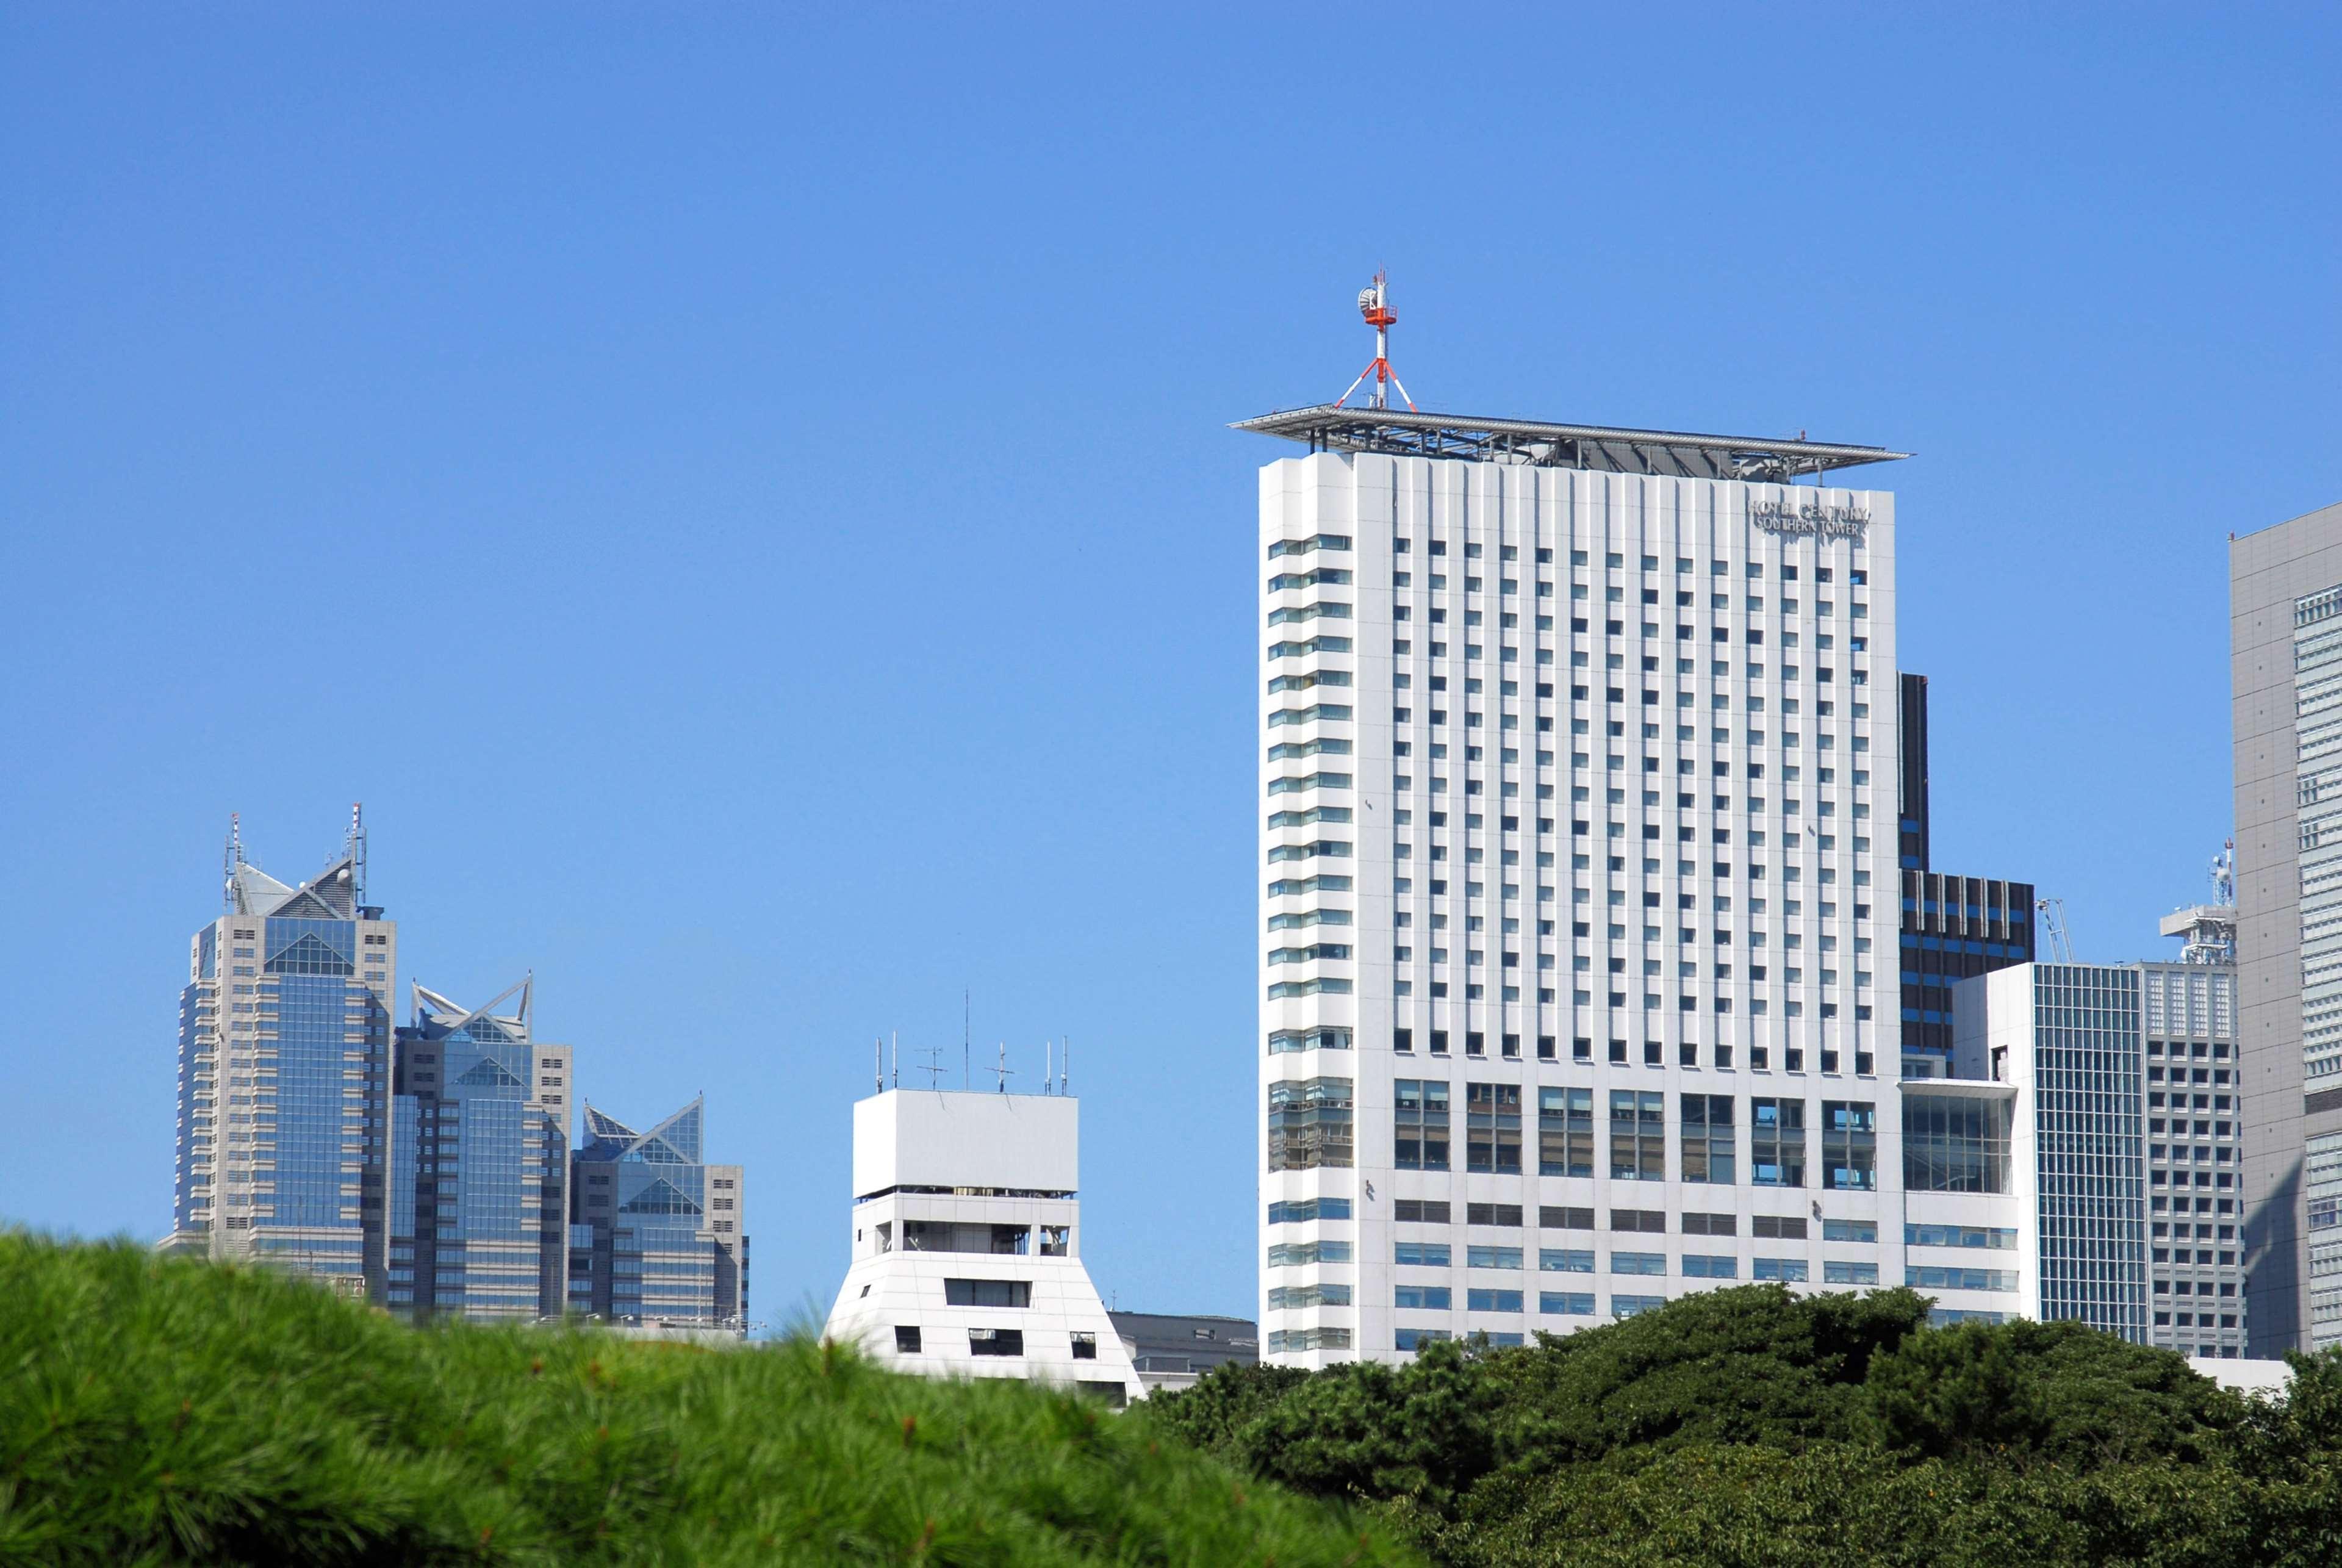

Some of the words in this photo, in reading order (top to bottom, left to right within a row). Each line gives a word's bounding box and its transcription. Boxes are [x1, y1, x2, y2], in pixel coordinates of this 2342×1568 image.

[1748, 500, 1797, 517] HOTEL
[1800, 504, 1869, 521] CENTURY
[1756, 516, 1816, 533] SOUTHERN
[1820, 520, 1859, 536] TOWER
